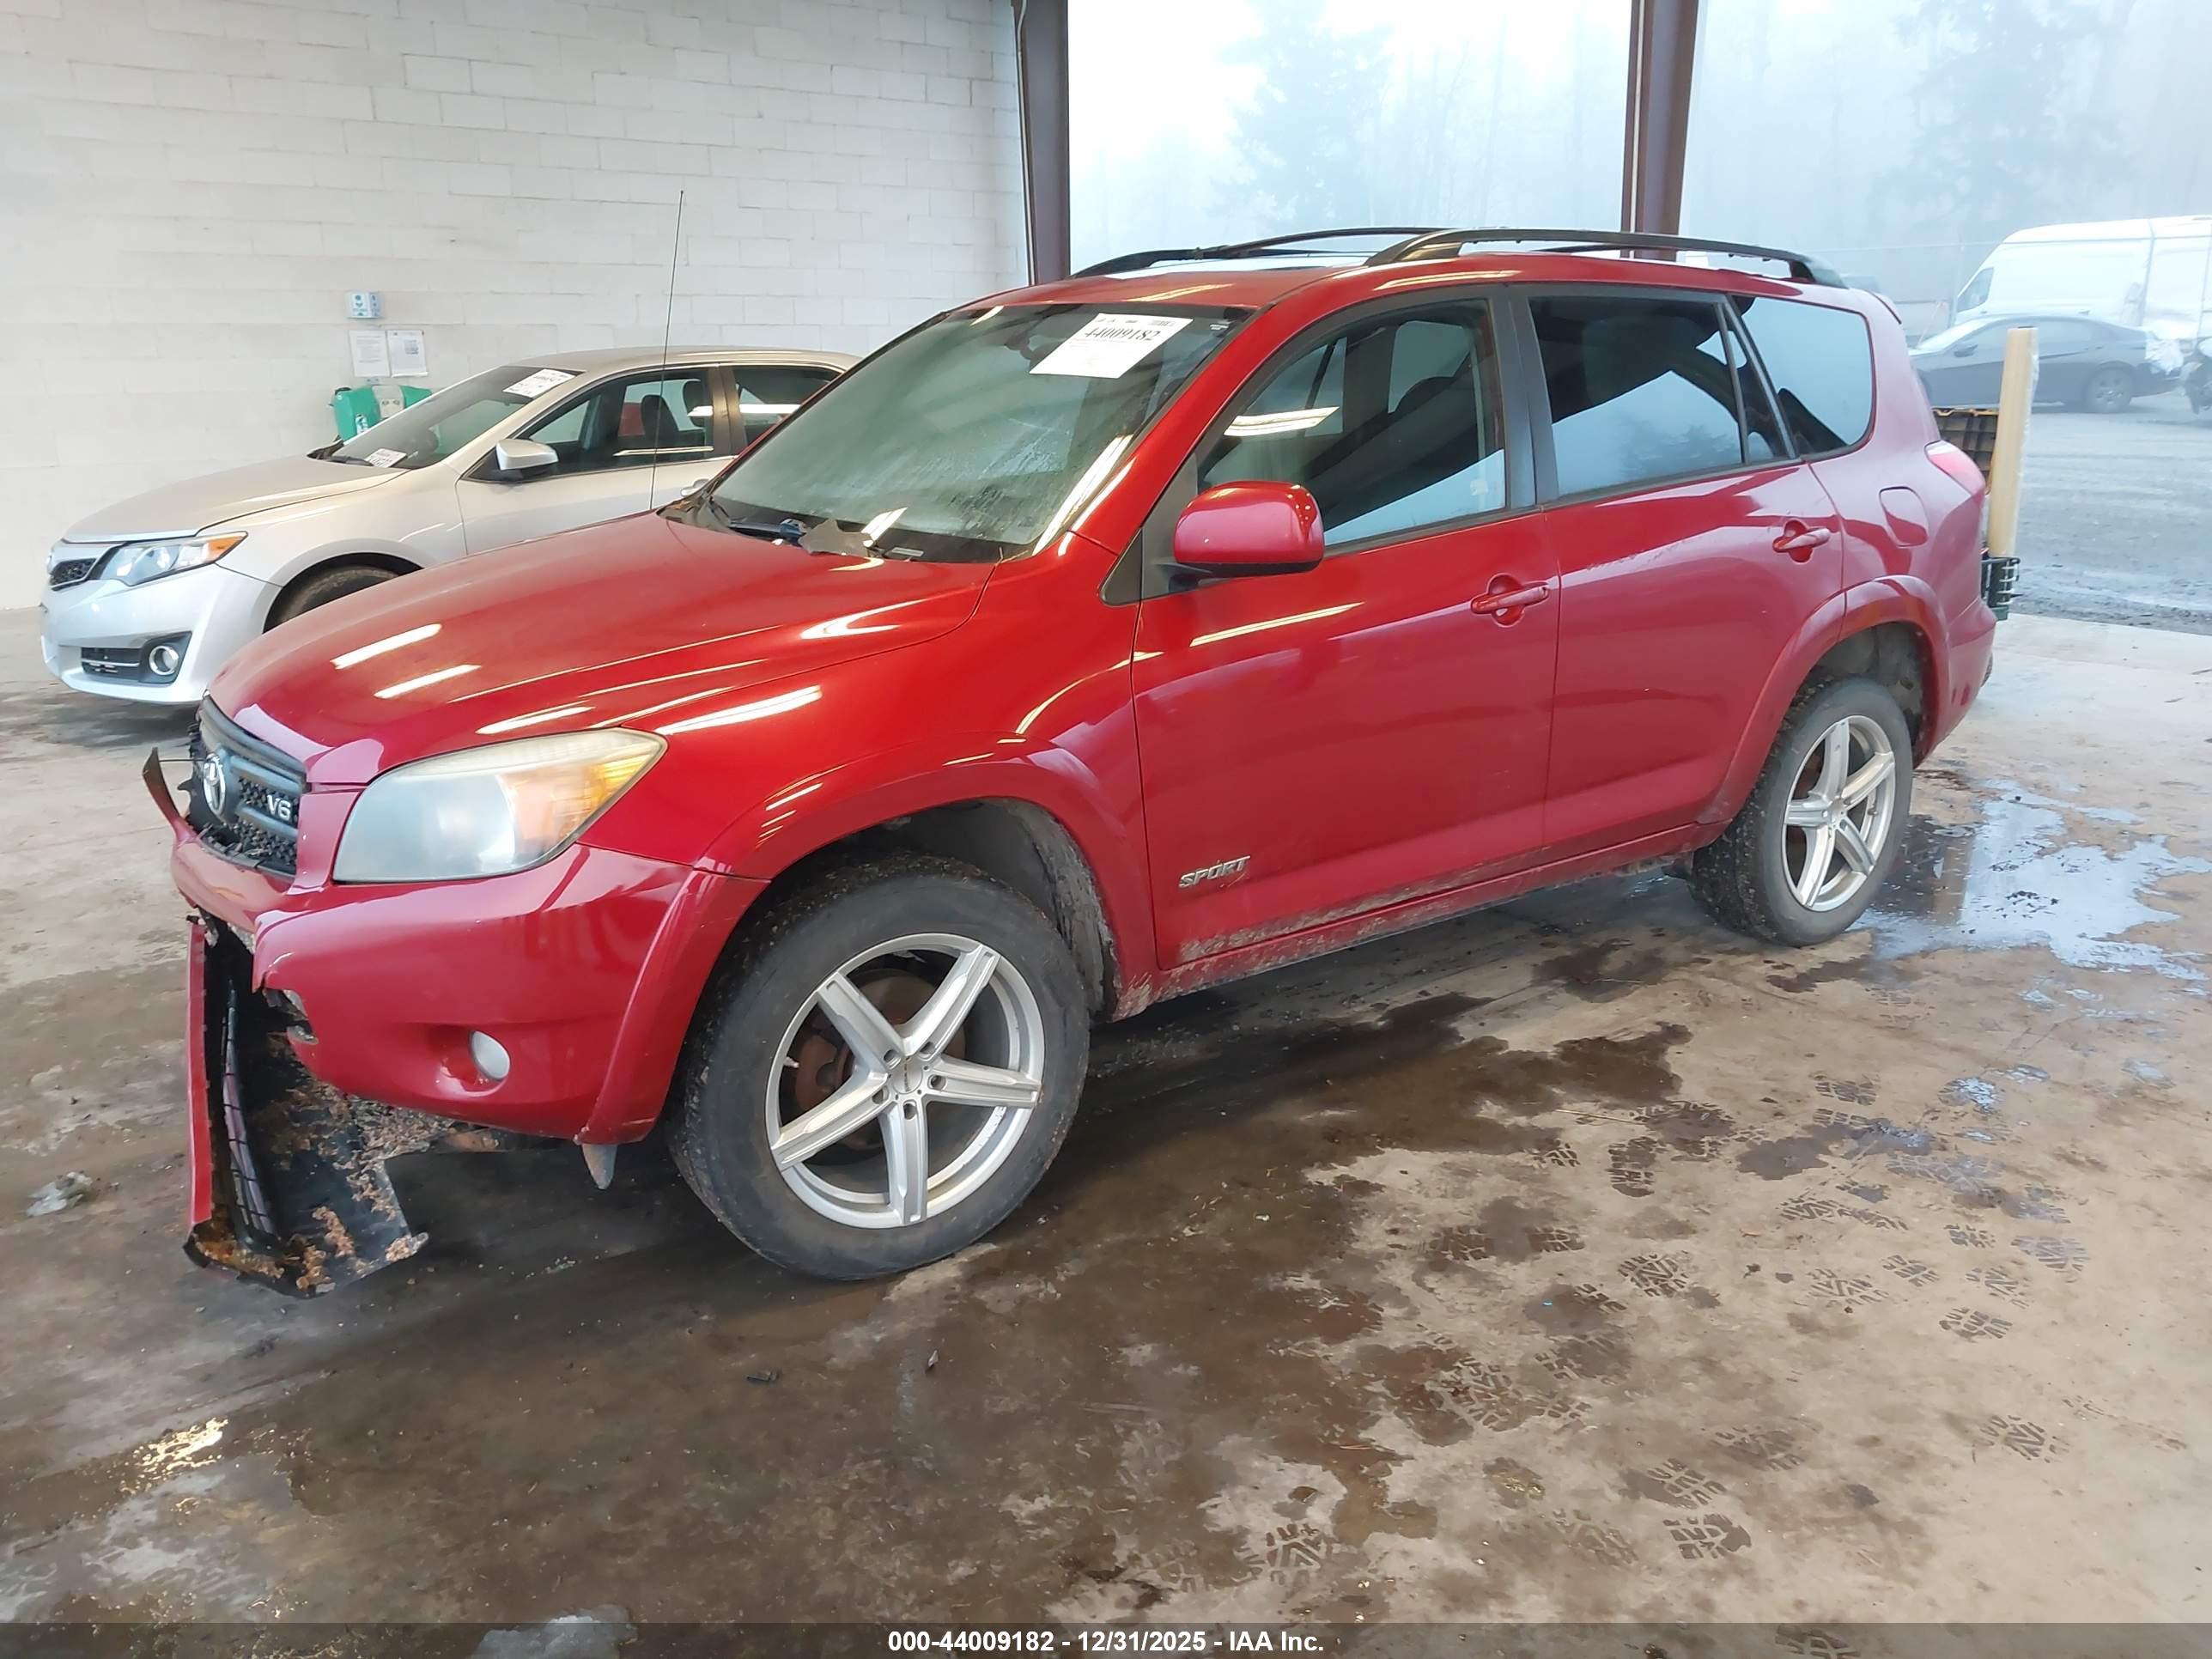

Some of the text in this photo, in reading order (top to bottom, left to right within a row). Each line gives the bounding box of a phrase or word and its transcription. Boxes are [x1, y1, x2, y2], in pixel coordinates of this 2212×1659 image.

[1085, 327, 1161, 341] 44009182
[267, 794, 291, 821] V6
[1178, 855, 1251, 888] SPORT
